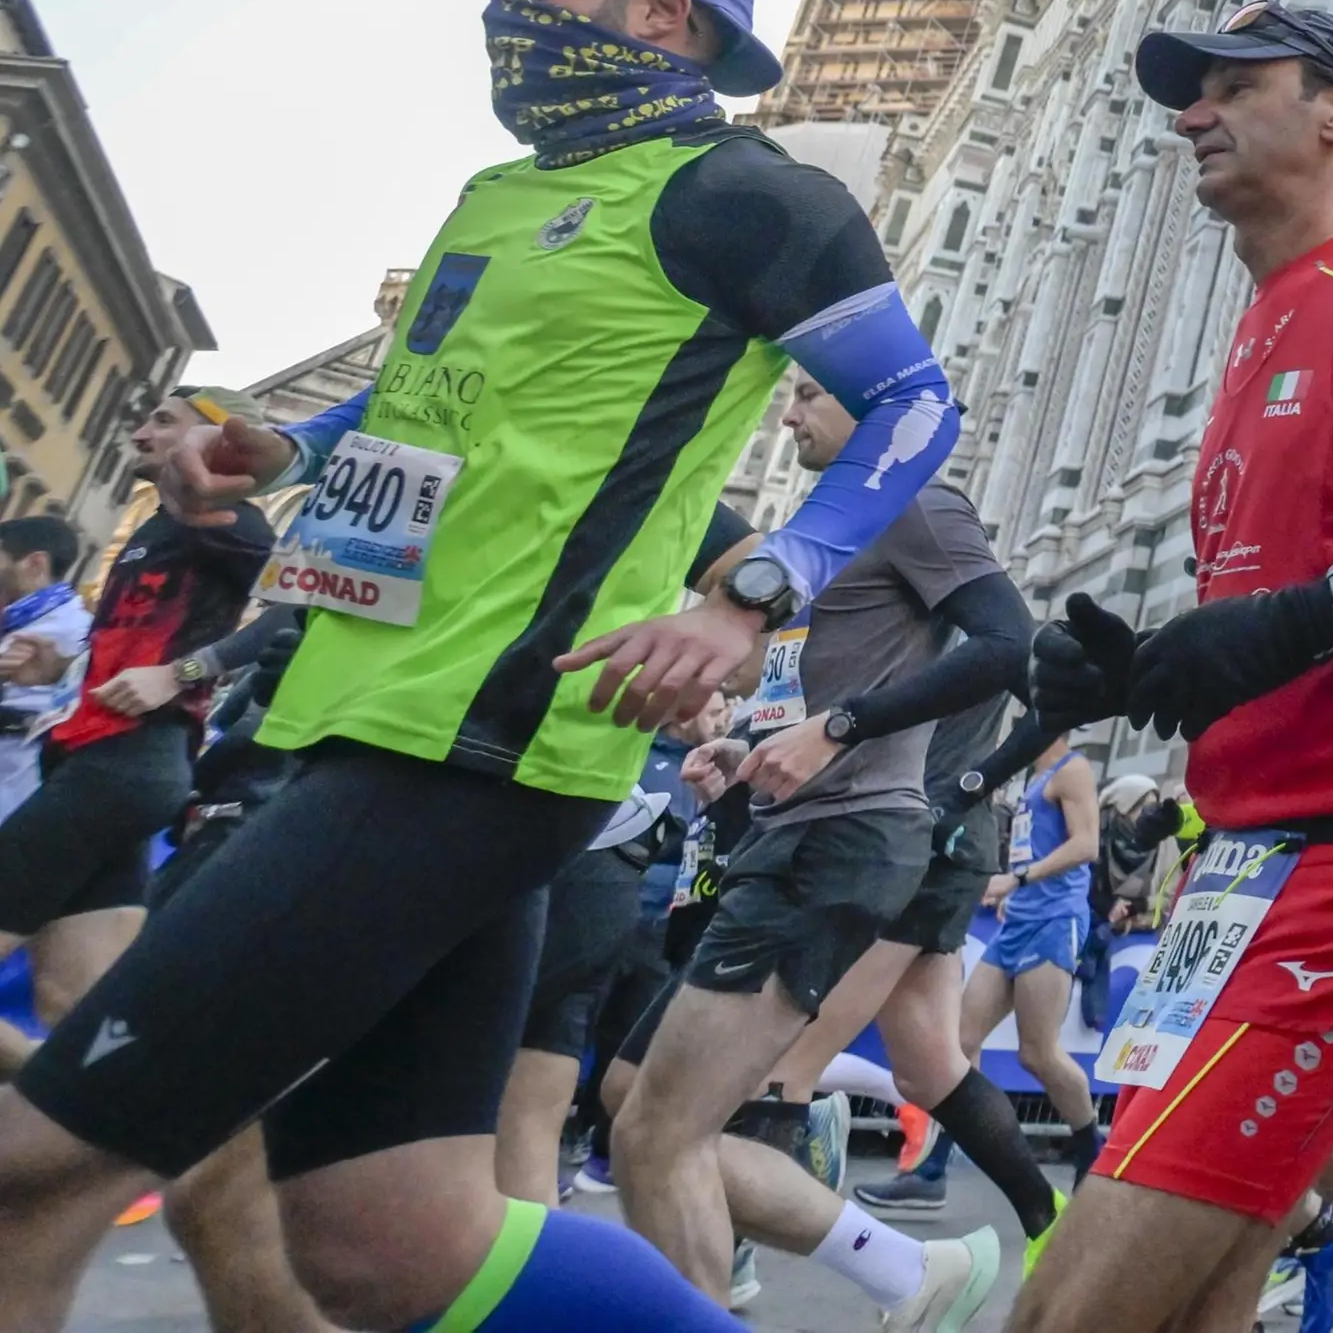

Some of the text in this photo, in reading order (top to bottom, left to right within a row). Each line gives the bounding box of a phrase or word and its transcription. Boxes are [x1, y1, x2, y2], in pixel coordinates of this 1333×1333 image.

[862, 376, 897, 401] ELBA
[1263, 401, 1301, 418] ITALIA
[300, 454, 406, 534] 5940
[278, 566, 381, 607] CONAD
